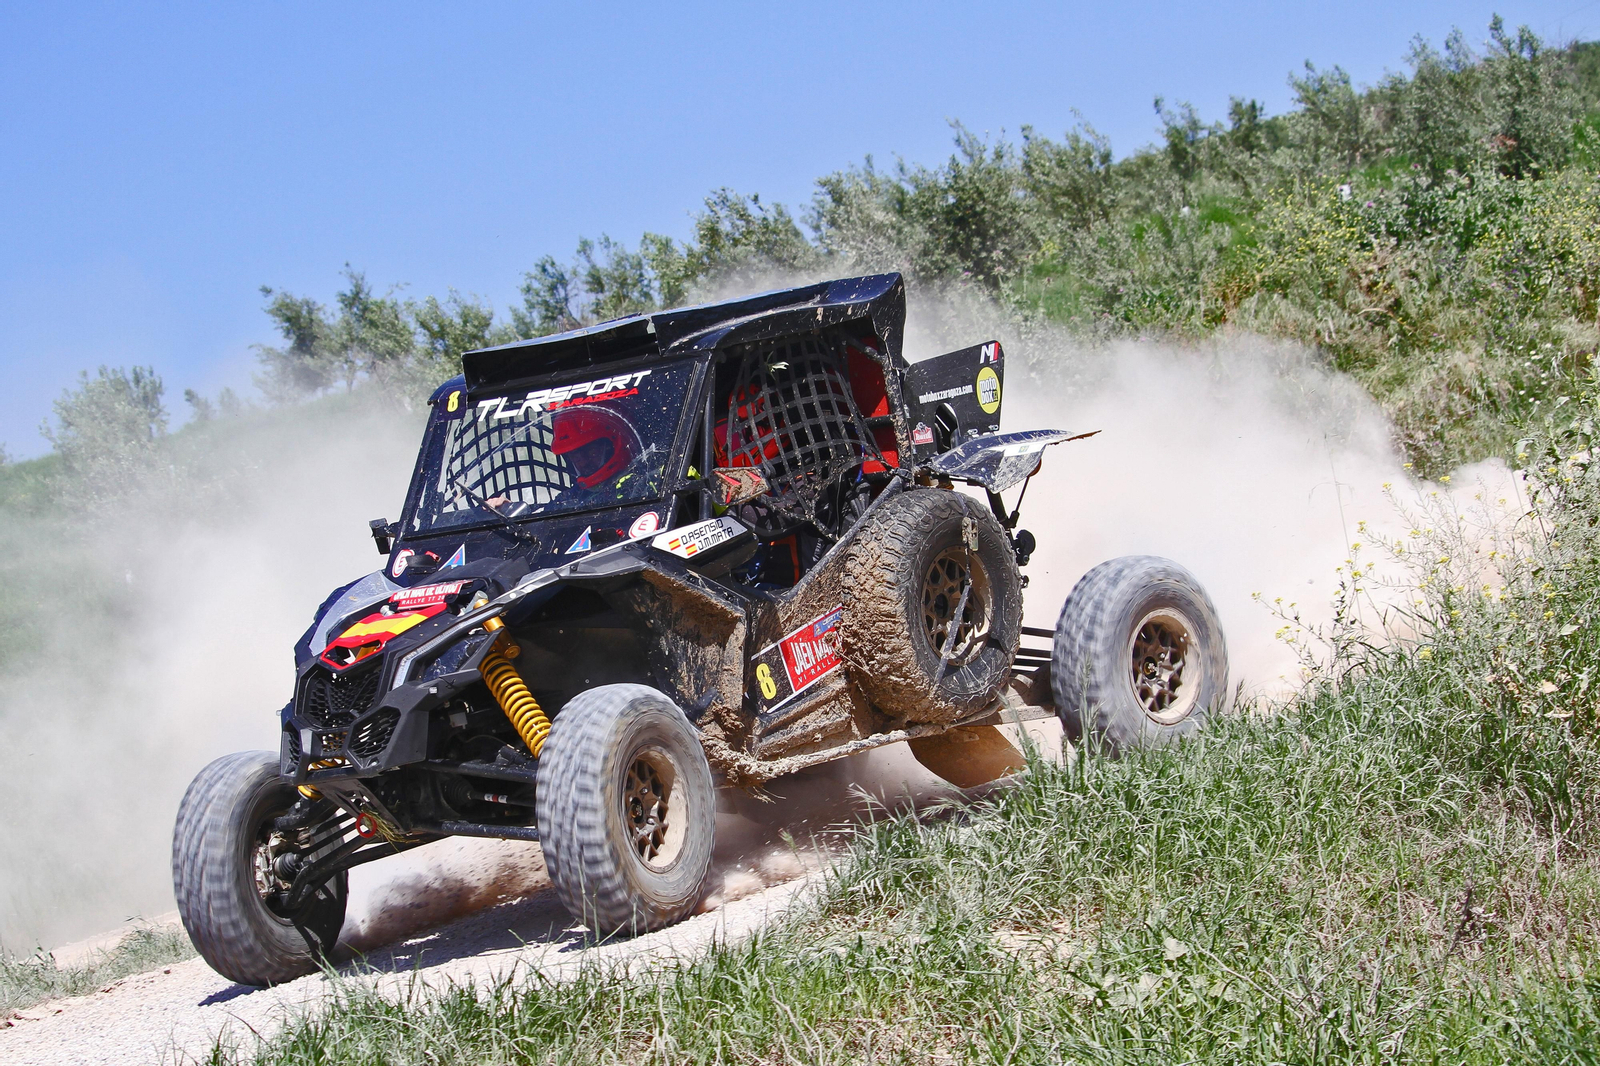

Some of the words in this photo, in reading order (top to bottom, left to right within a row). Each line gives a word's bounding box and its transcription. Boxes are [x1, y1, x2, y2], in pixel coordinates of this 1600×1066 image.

[919, 385, 973, 404] motoboxzaragoza.com
[980, 377, 996, 393] moto
[447, 390, 461, 412] 8
[546, 387, 639, 411] ZARAGOZA
[756, 663, 777, 700] 8
